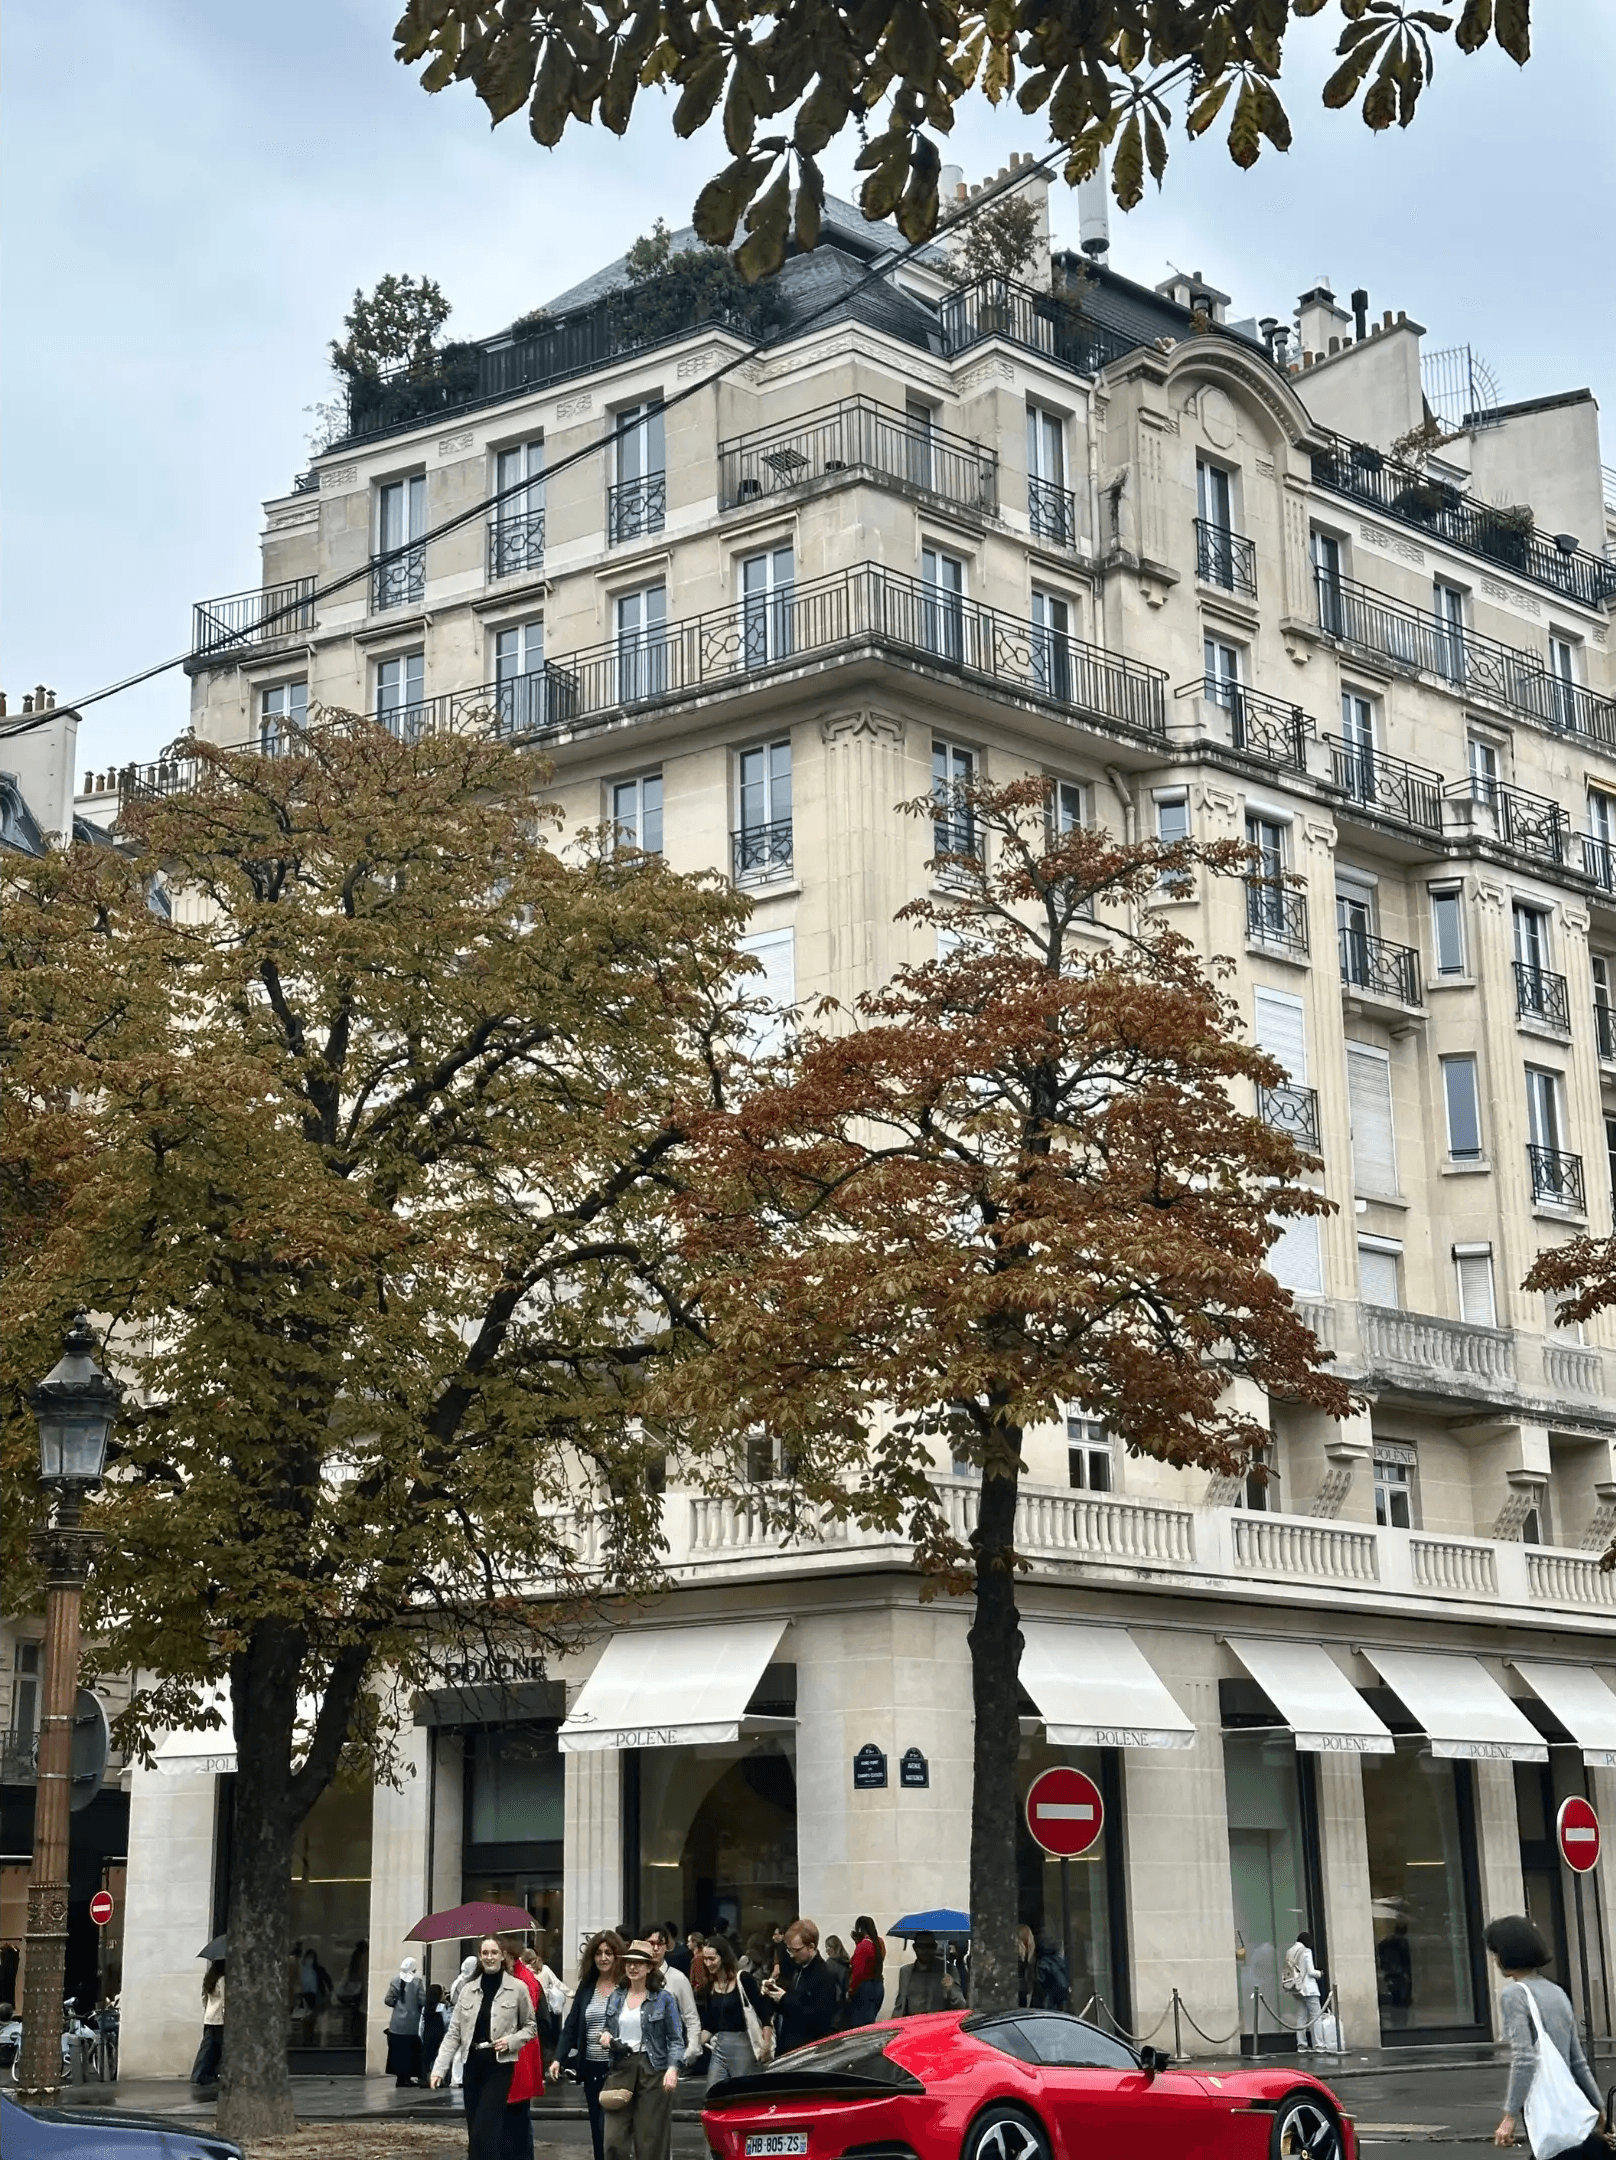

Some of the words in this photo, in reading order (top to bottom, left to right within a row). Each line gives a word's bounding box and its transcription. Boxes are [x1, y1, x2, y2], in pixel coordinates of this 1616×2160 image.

[1373, 1447, 1415, 1464] POLÈNE
[616, 1727, 678, 1747] POLÈNE
[1096, 1728, 1149, 1746] POLÈNE
[1322, 1734, 1370, 1751] POLÈNE
[1469, 1743, 1512, 1759] POLÈNE
[207, 1757, 237, 1772] POL
